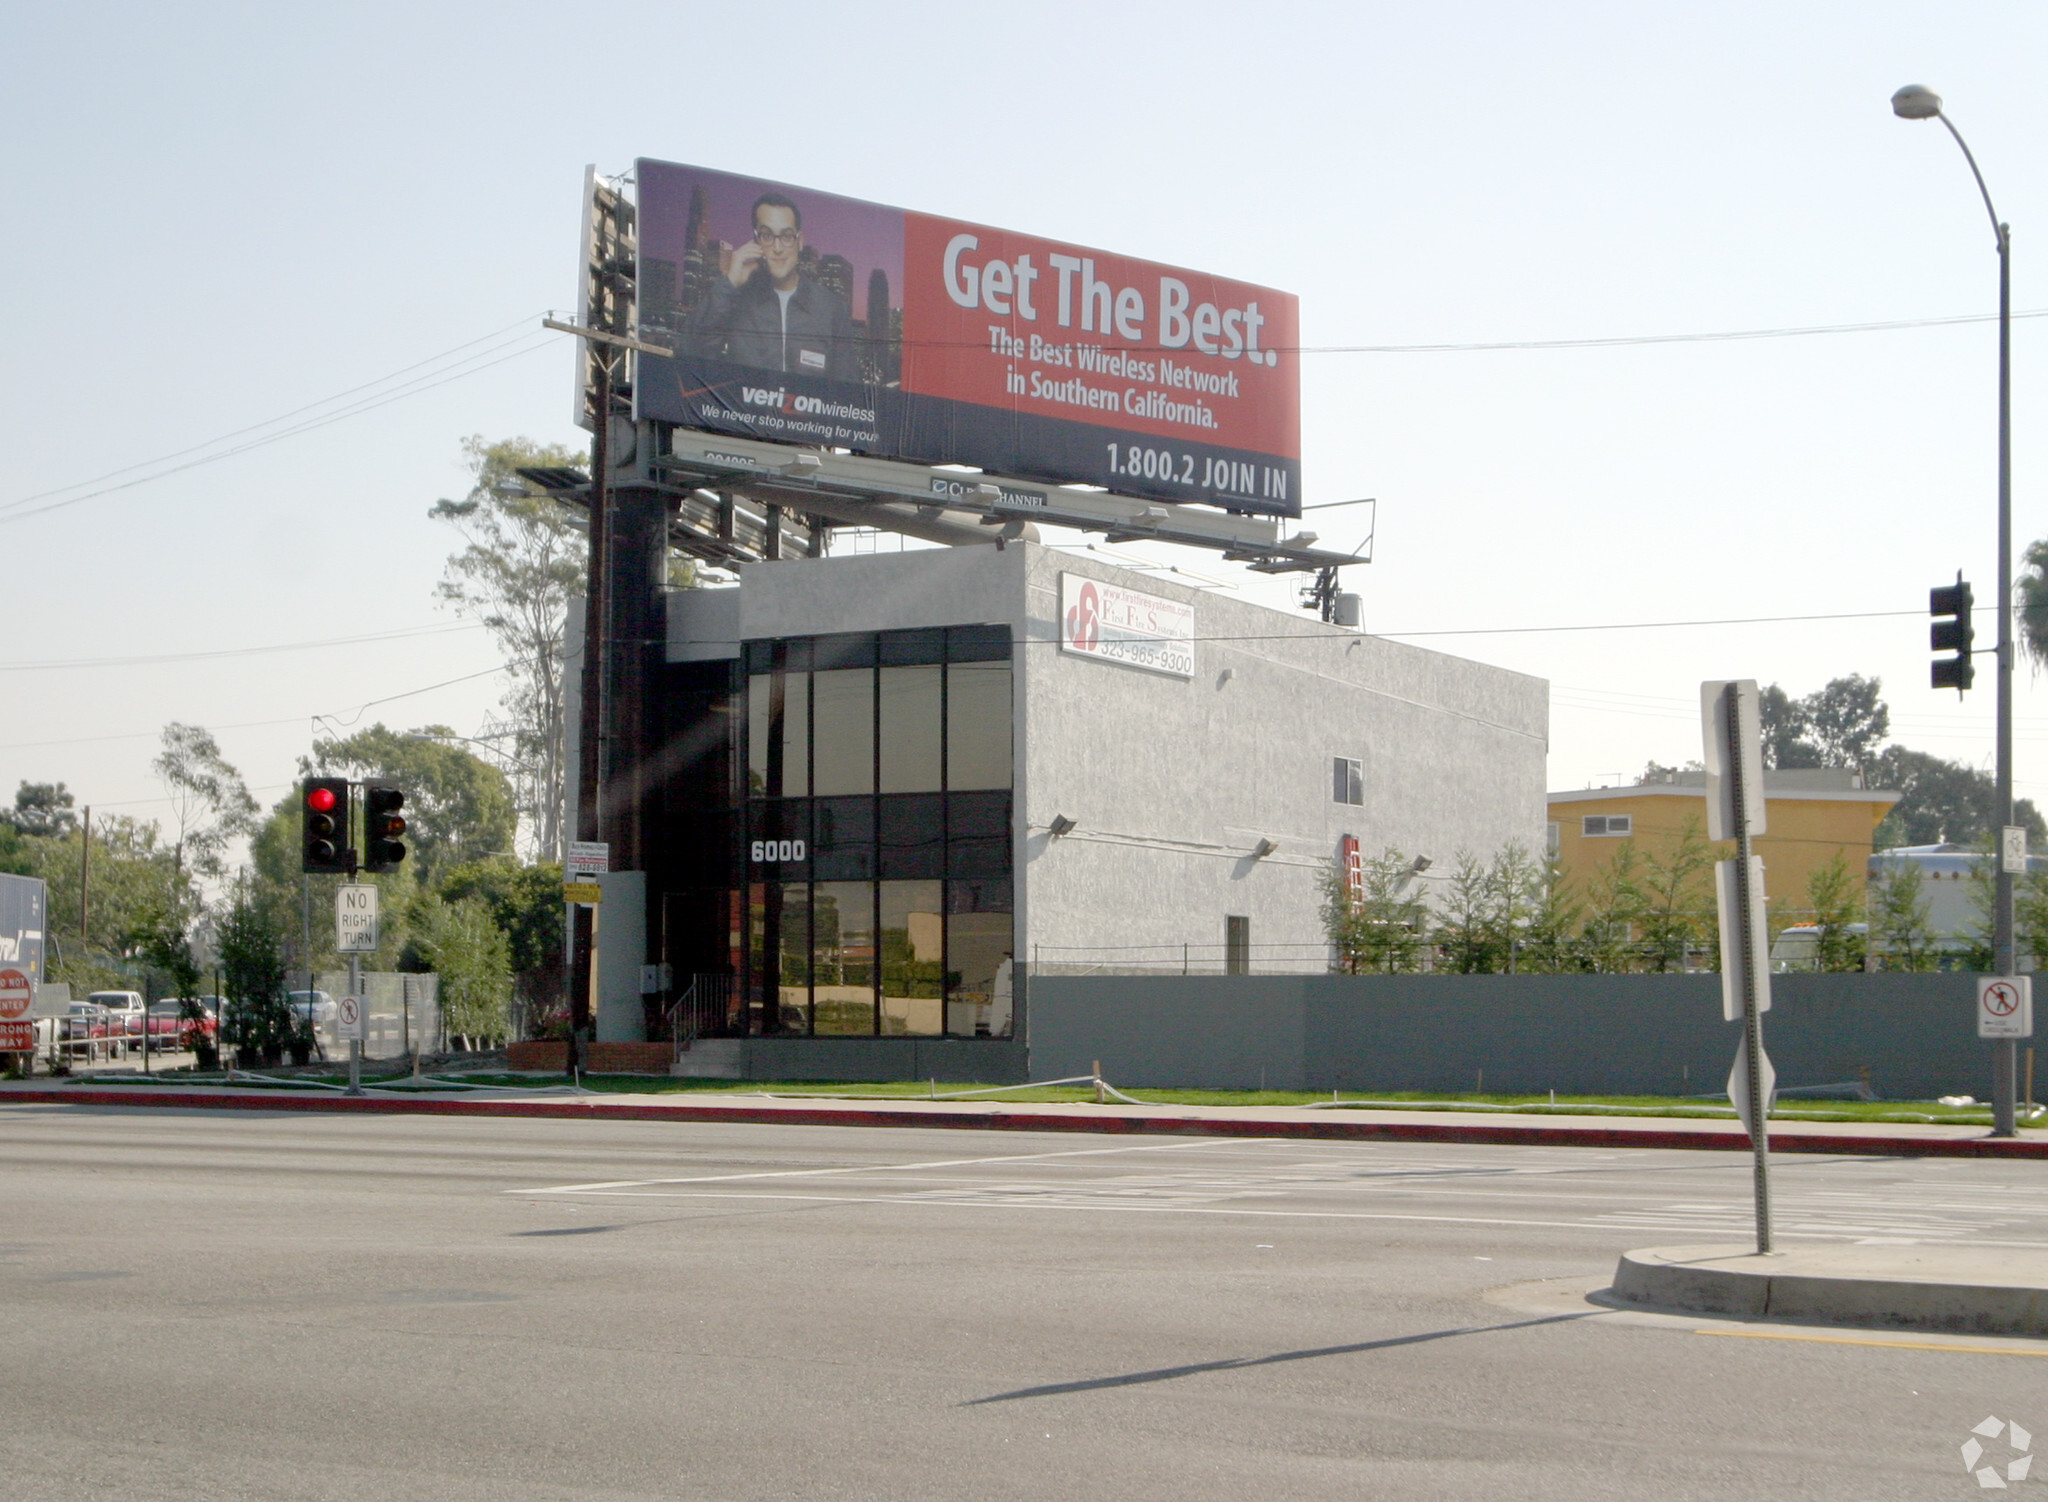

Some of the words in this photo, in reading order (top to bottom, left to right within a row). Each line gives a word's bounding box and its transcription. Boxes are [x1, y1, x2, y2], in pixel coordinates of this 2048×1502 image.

[943, 233, 1038, 322] Get
[1049, 252, 1146, 342] The
[1158, 276, 1278, 368] Best.
[988, 325, 1024, 359] The
[1029, 333, 1073, 369] Best
[1077, 343, 1156, 384] Wireless
[1159, 358, 1239, 399] Network
[1006, 364, 1026, 397] in
[1030, 369, 1120, 413] Southern
[1124, 388, 1219, 430] California.
[701, 404, 721, 419] We
[722, 409, 757, 426] never
[758, 414, 785, 431] stop
[786, 419, 834, 439] working
[834, 425, 852, 439] for
[1106, 443, 1194, 485] 1.800.2
[1201, 457, 1255, 496] JOIN
[1264, 466, 1287, 500] IN
[1101, 640, 1192, 673] 323-965-9300
[752, 840, 806, 862] 6000
[346, 893, 367, 909] NO
[342, 914, 373, 928] RIGHT
[344, 931, 372, 945] TURN
[8, 978, 25, 987] NOT
[0, 1000, 25, 1010] NTER
[0, 1023, 31, 1035] RONG
